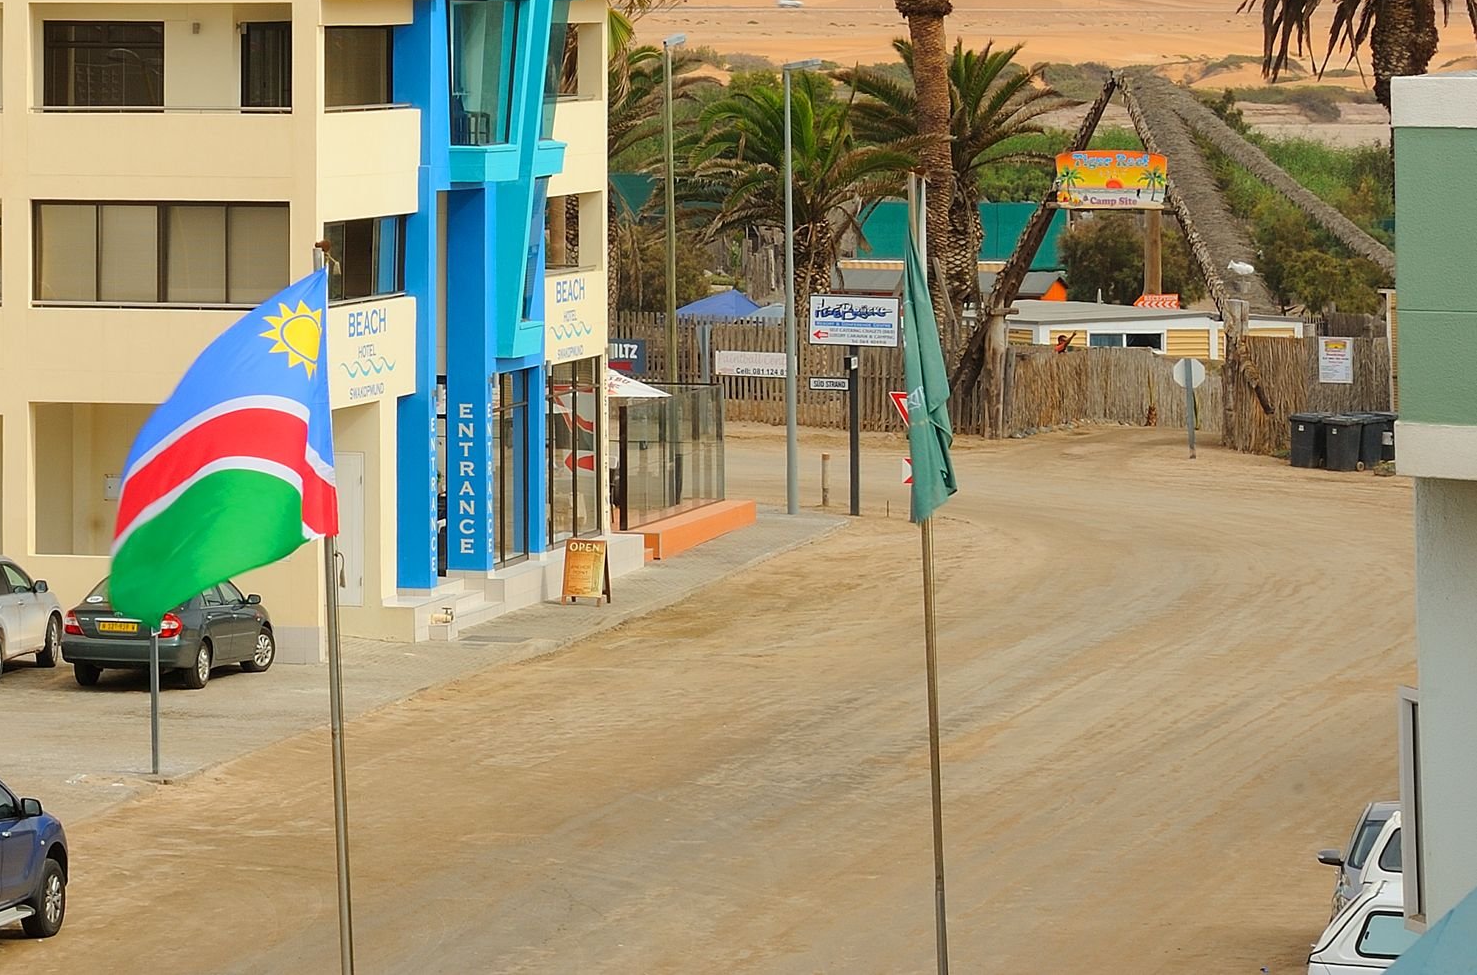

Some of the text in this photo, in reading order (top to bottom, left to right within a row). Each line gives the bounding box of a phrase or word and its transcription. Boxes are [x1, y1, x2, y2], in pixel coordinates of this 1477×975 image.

[1090, 197, 1117, 206] Camp
[1118, 196, 1138, 205] Site
[556, 278, 585, 303] BEACH
[348, 308, 386, 337] BEACH
[358, 344, 376, 358] HOTEL
[349, 382, 384, 400] SWAKOPMUND
[457, 403, 476, 554] ENTRANCE
[569, 542, 600, 552] OPEN
